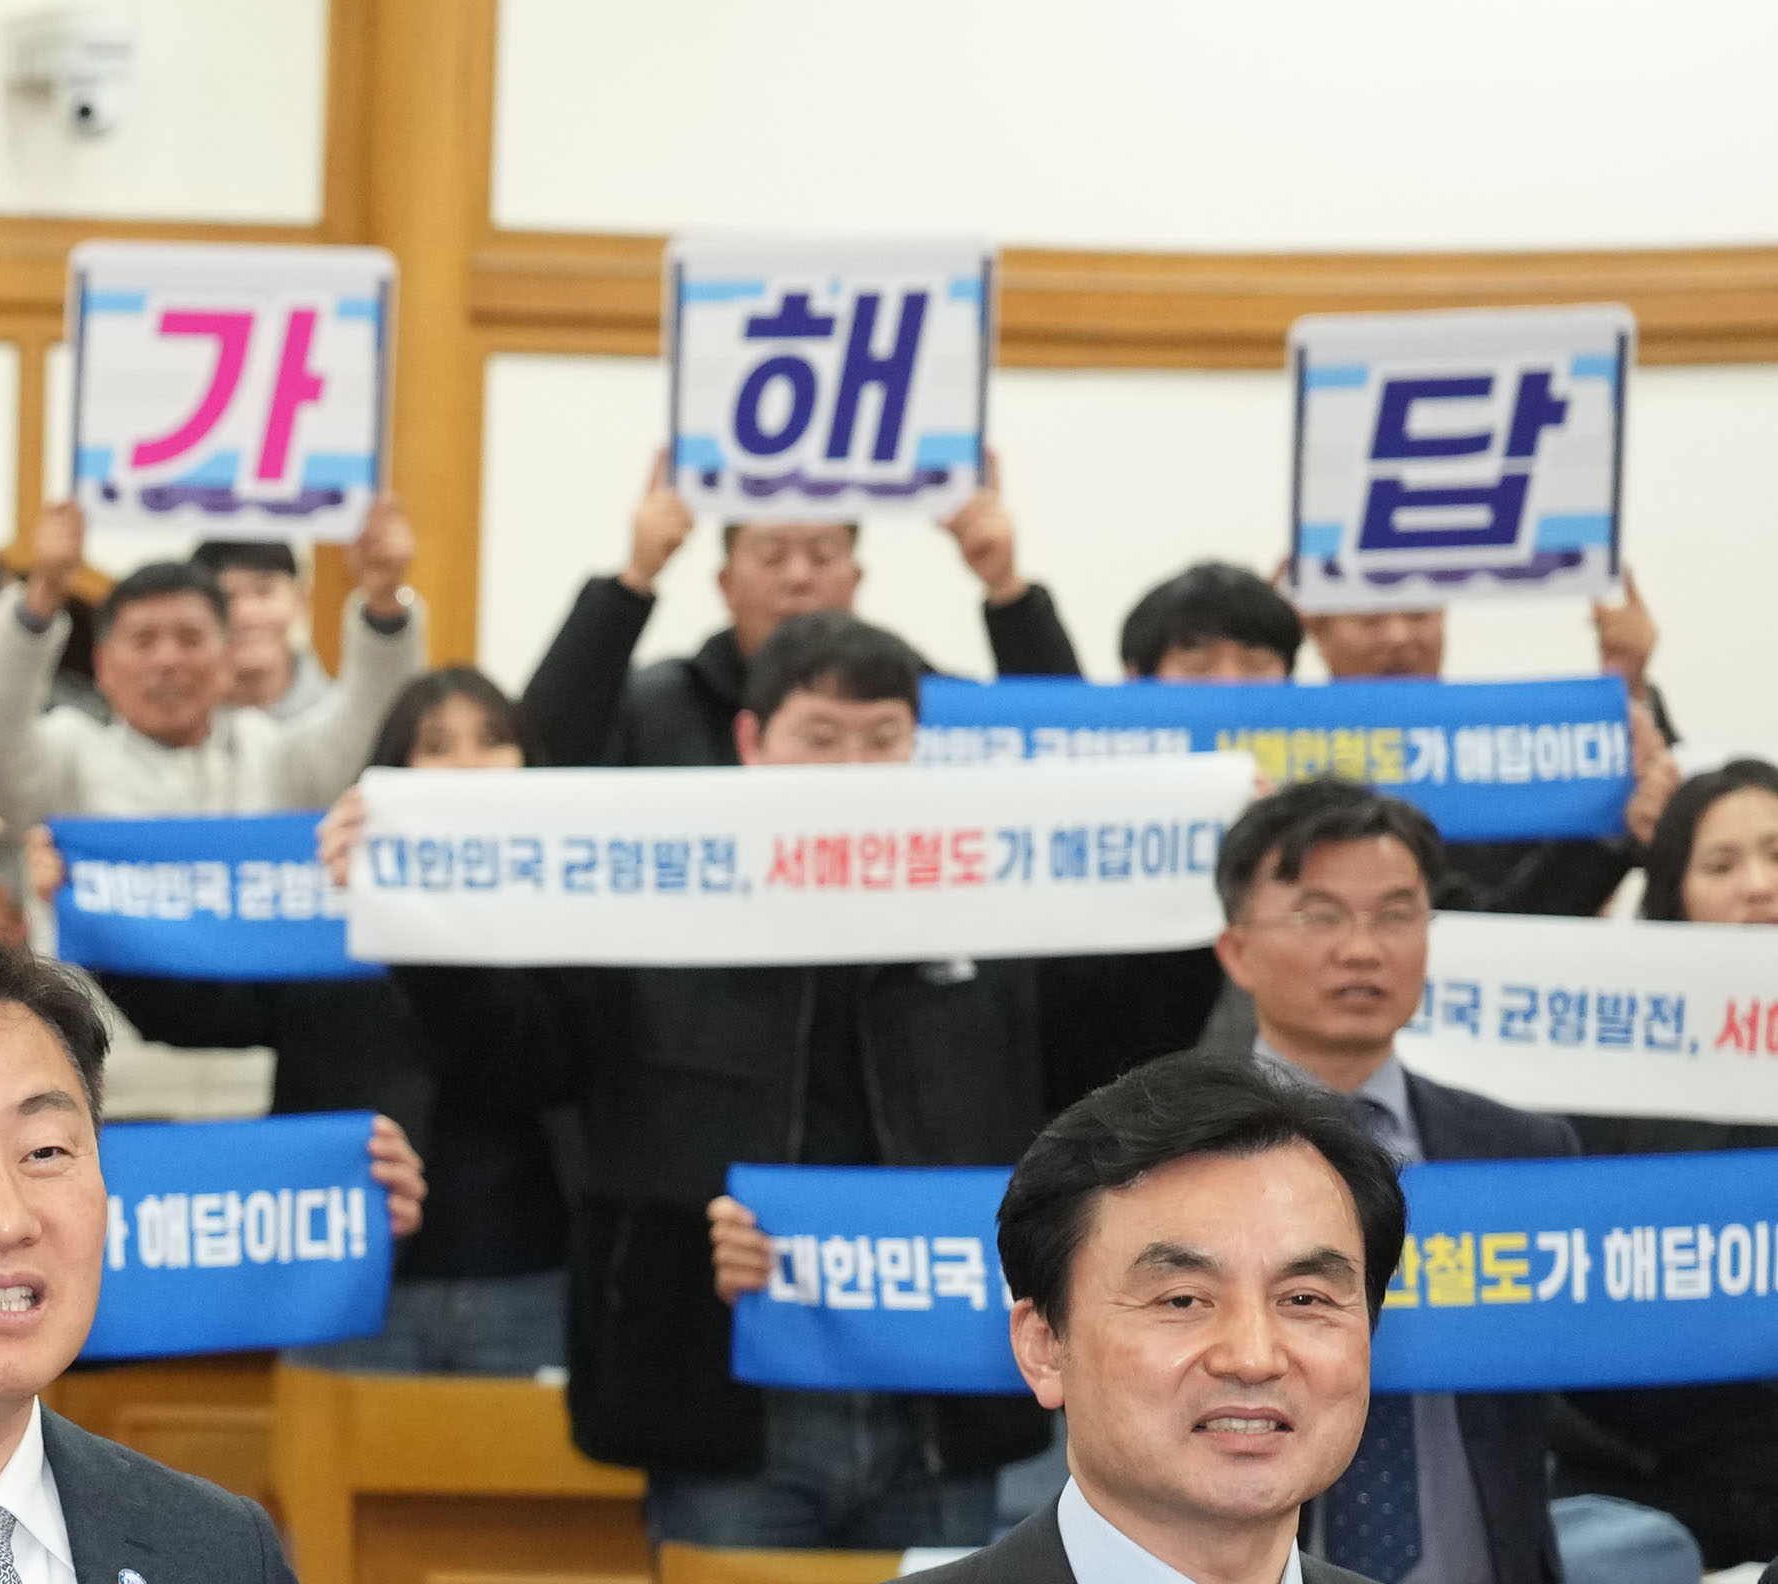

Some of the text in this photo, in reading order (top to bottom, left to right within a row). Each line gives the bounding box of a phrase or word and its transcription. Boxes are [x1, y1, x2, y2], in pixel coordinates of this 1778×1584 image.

[129, 308, 327, 481] 가
[730, 291, 931, 463] 해
[1357, 370, 1571, 553] 답
[368, 836, 544, 892] 대한민국
[765, 826, 1035, 891] 서해안철도가
[1499, 982, 1698, 1056] 균형발전,
[134, 1185, 368, 1269] 해답이다!
[1603, 1220, 1778, 1301] 해답이
[768, 1234, 987, 1311] 대한민국
